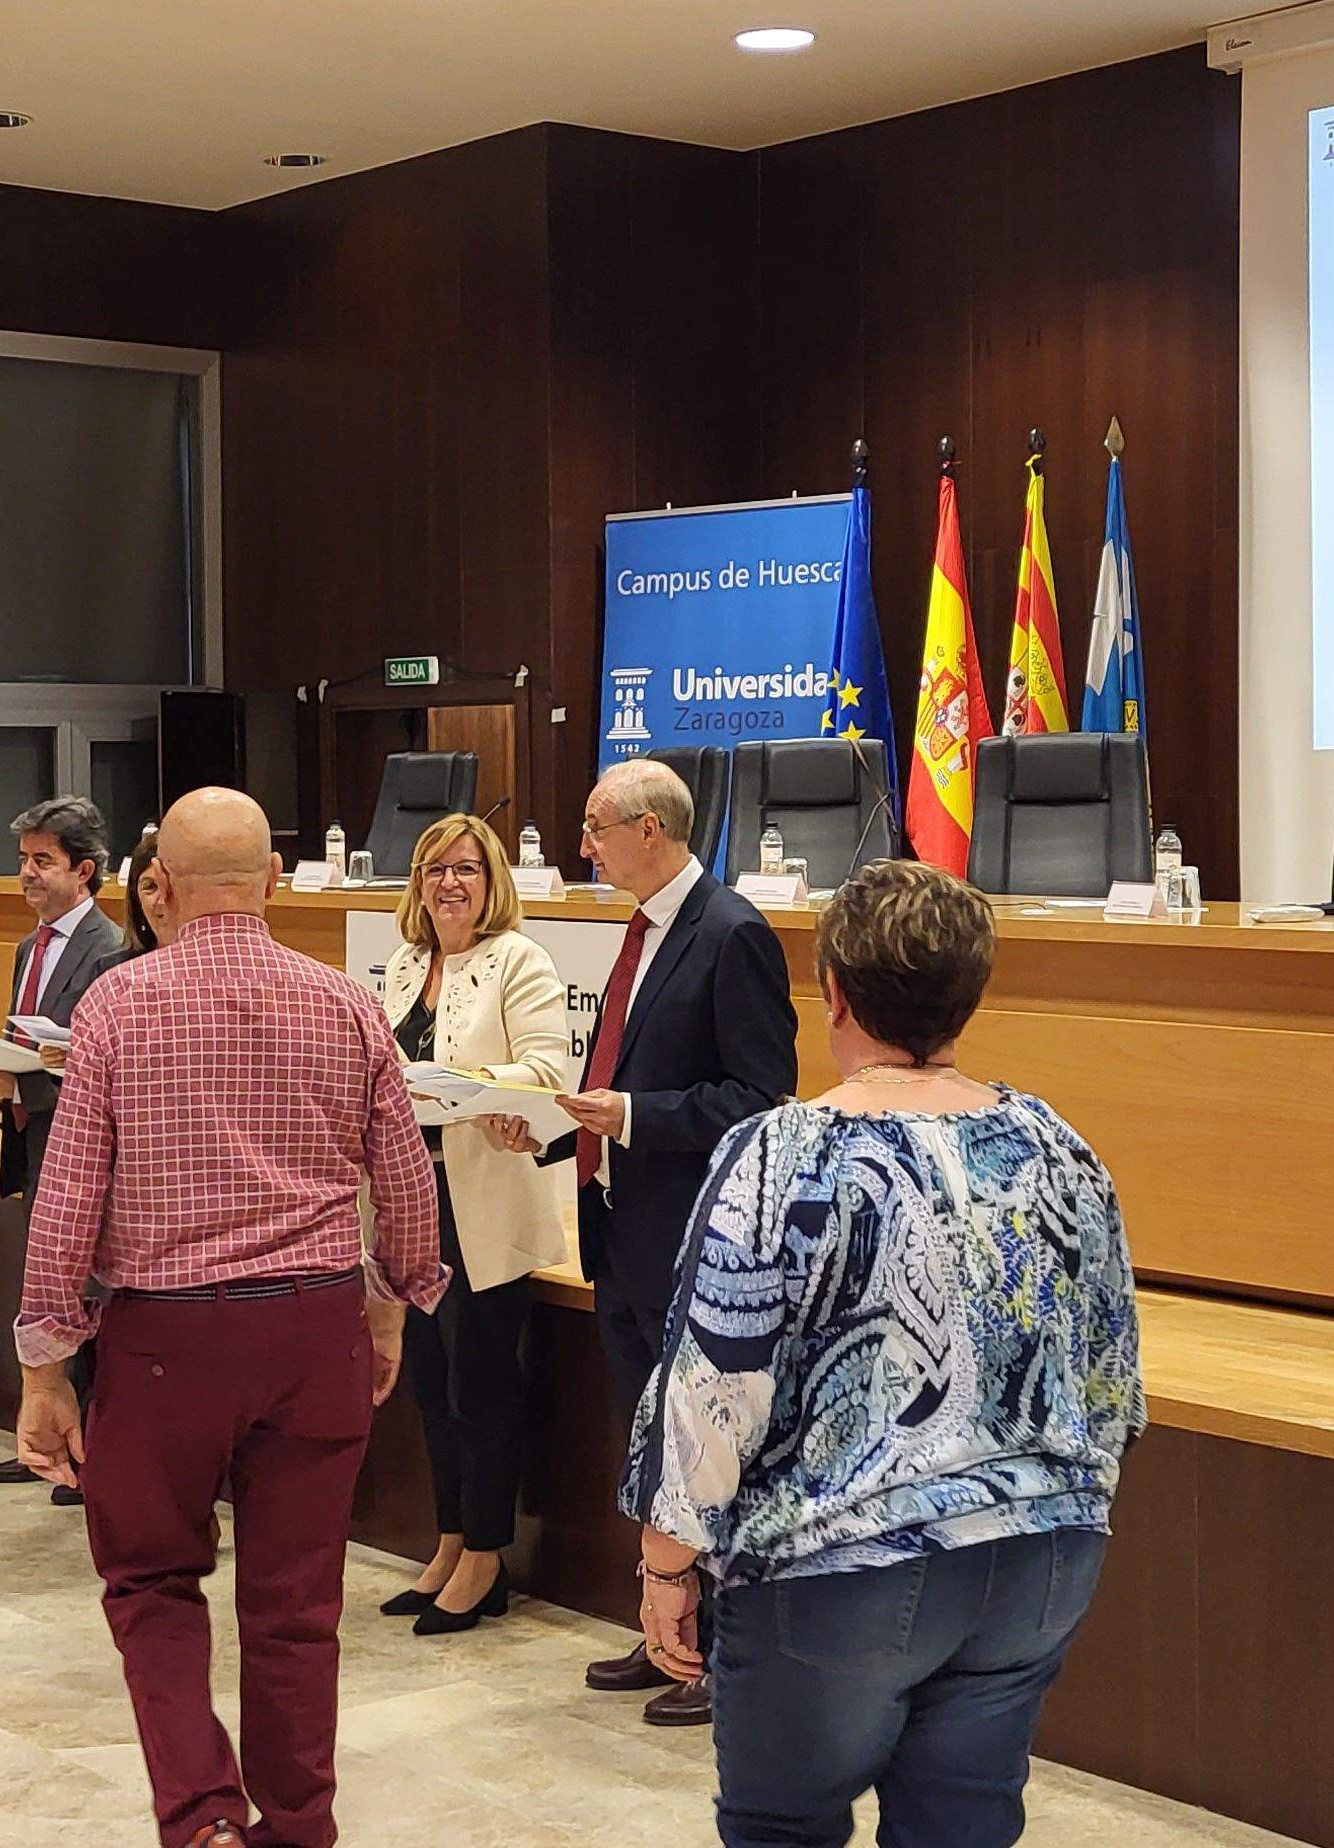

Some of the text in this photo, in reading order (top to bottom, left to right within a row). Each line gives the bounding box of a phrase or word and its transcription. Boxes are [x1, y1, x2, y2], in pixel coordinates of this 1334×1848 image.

[617, 569, 711, 599] Campus
[719, 560, 750, 589] de
[389, 662, 426, 680] SALIDA
[672, 663, 829, 702] Universida
[673, 707, 784, 736] Zaragoza
[614, 743, 640, 754] 1542
